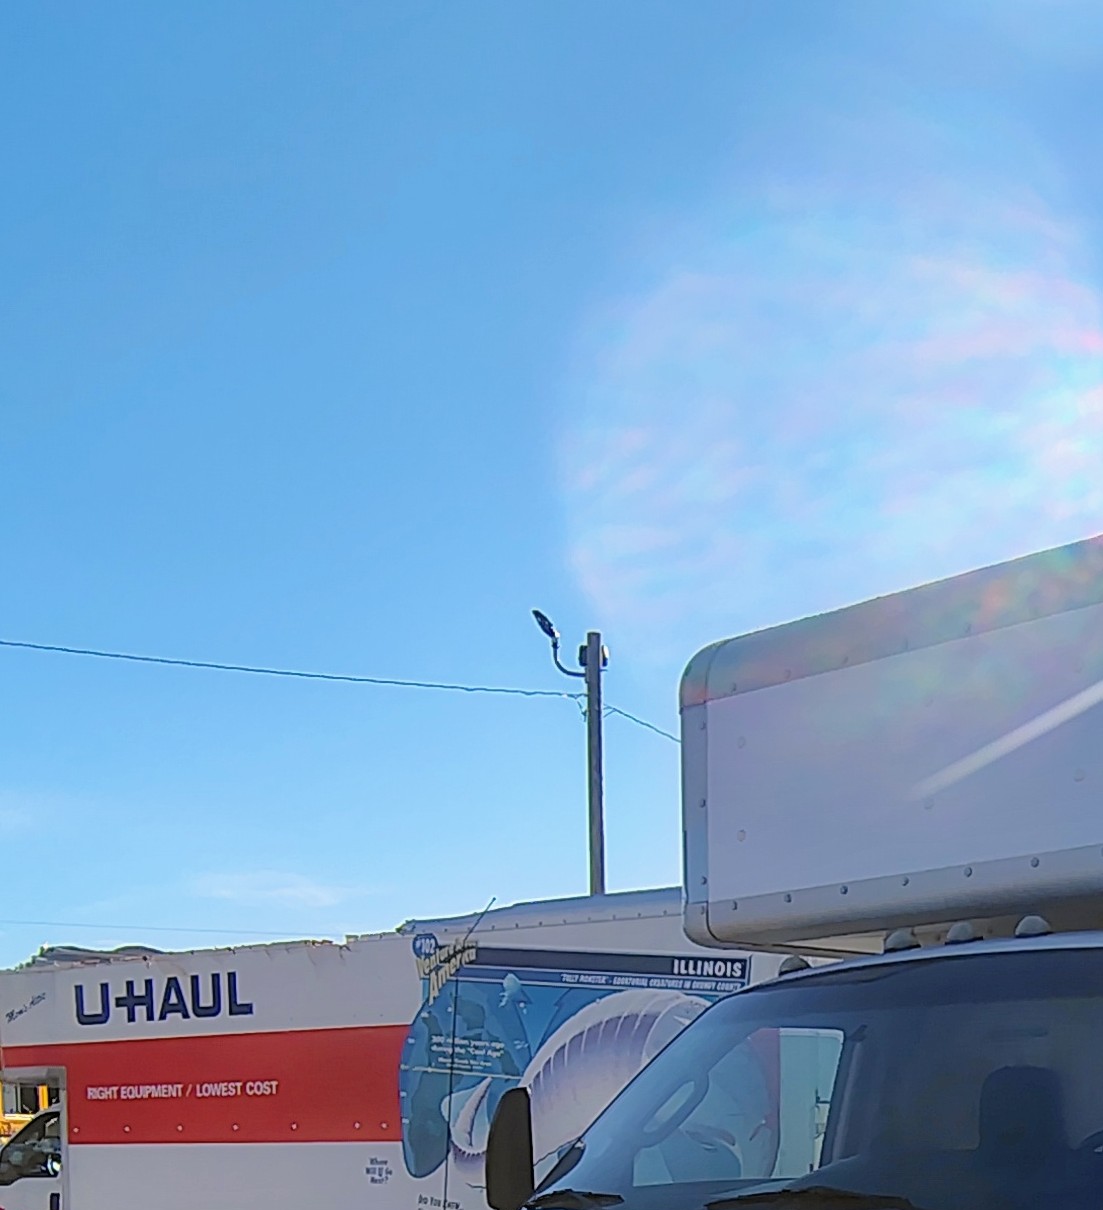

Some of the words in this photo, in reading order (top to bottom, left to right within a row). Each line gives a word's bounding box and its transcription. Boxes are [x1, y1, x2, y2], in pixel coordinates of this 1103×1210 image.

[673, 959, 742, 977] ILLINOIS
[86, 1086, 119, 1100] RIGHT
[120, 1084, 183, 1100] EQUIPMENT
[196, 1082, 243, 1097] LOWEST
[245, 1080, 278, 1096] COST
